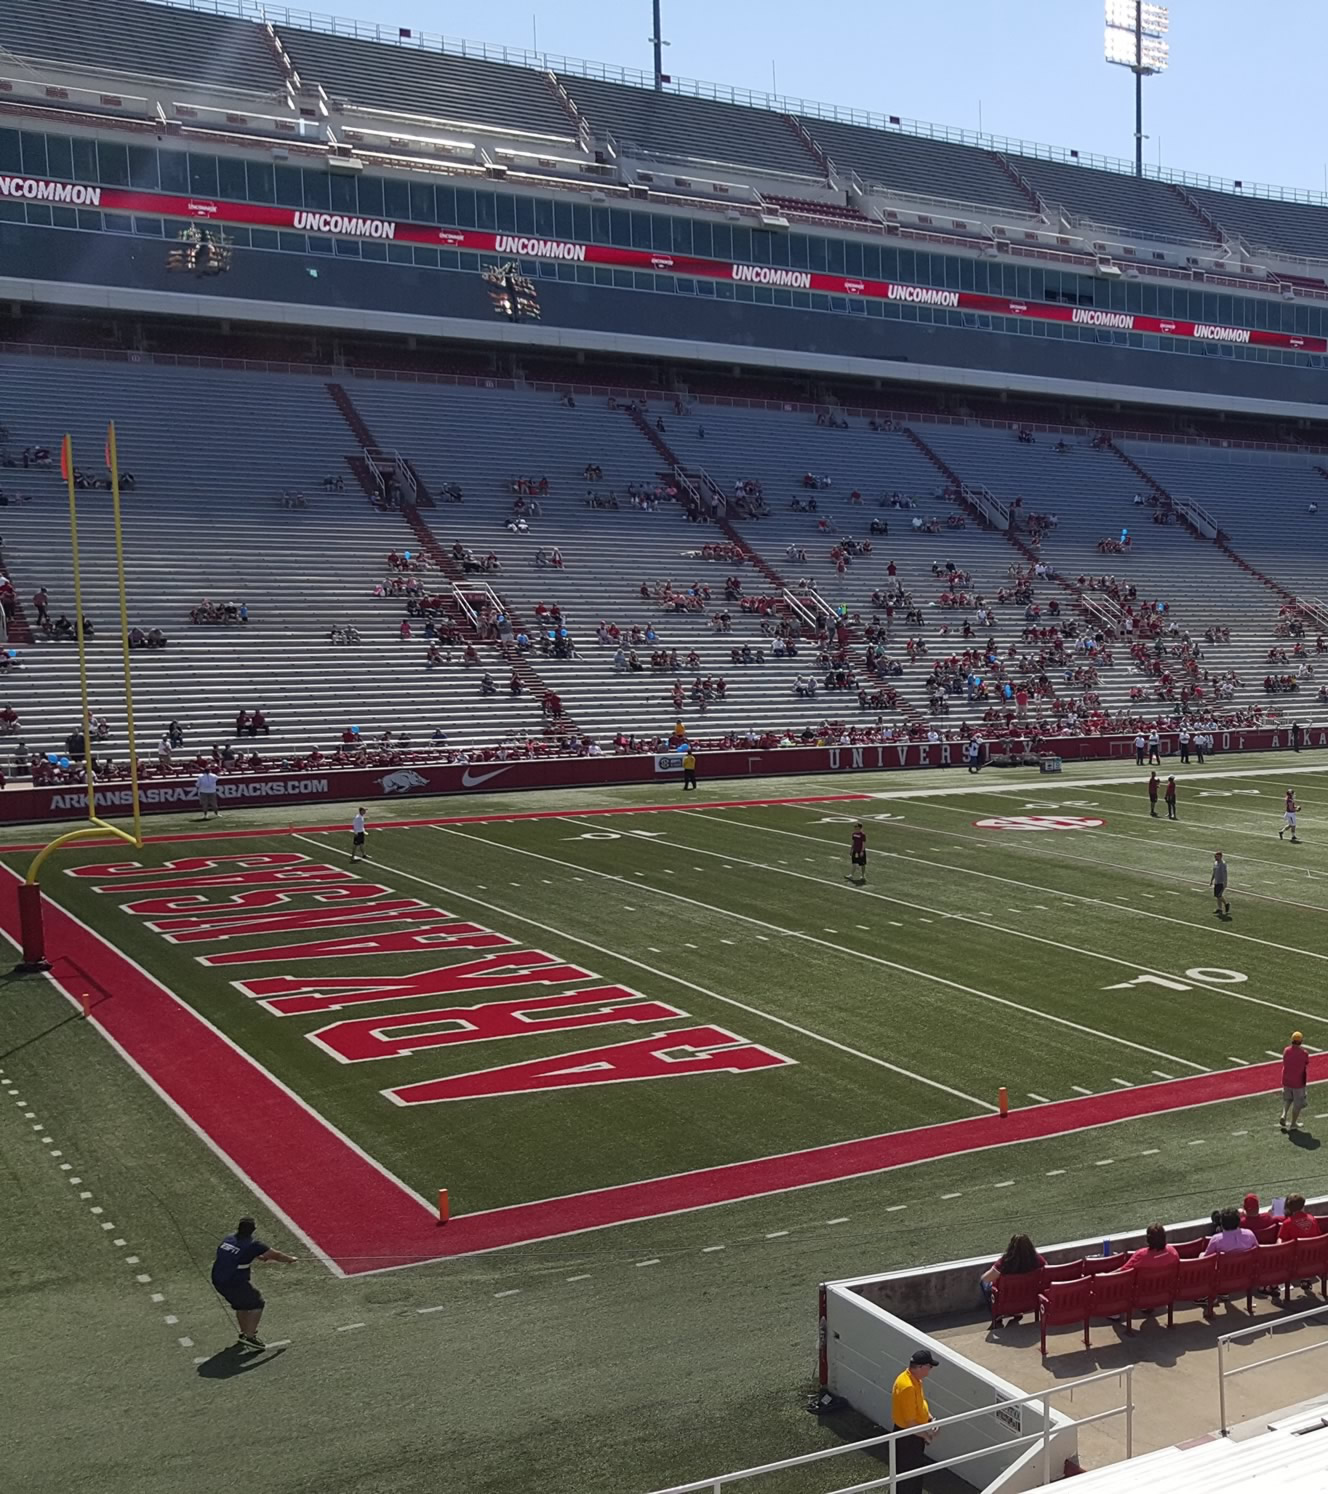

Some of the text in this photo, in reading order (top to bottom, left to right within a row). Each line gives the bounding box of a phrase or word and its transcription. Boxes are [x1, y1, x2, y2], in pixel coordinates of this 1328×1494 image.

[0, 176, 101, 206] NCOMMON
[293, 211, 396, 240] UNCOMMON
[495, 235, 586, 262] UNCOMMON
[732, 264, 811, 289] UNCOMMON
[888, 284, 959, 308] UNCOMMON
[1072, 308, 1134, 329] UNCOMMON
[1193, 324, 1251, 343] UNCOMMON
[1222, 732, 1247, 749] OF
[50, 779, 328, 810] ARKANSASRAZRBACKS.COM
[63, 852, 798, 1107] ARKANSAS
[1120, 967, 1249, 991] 10
[220, 1242, 241, 1255] ESPN
